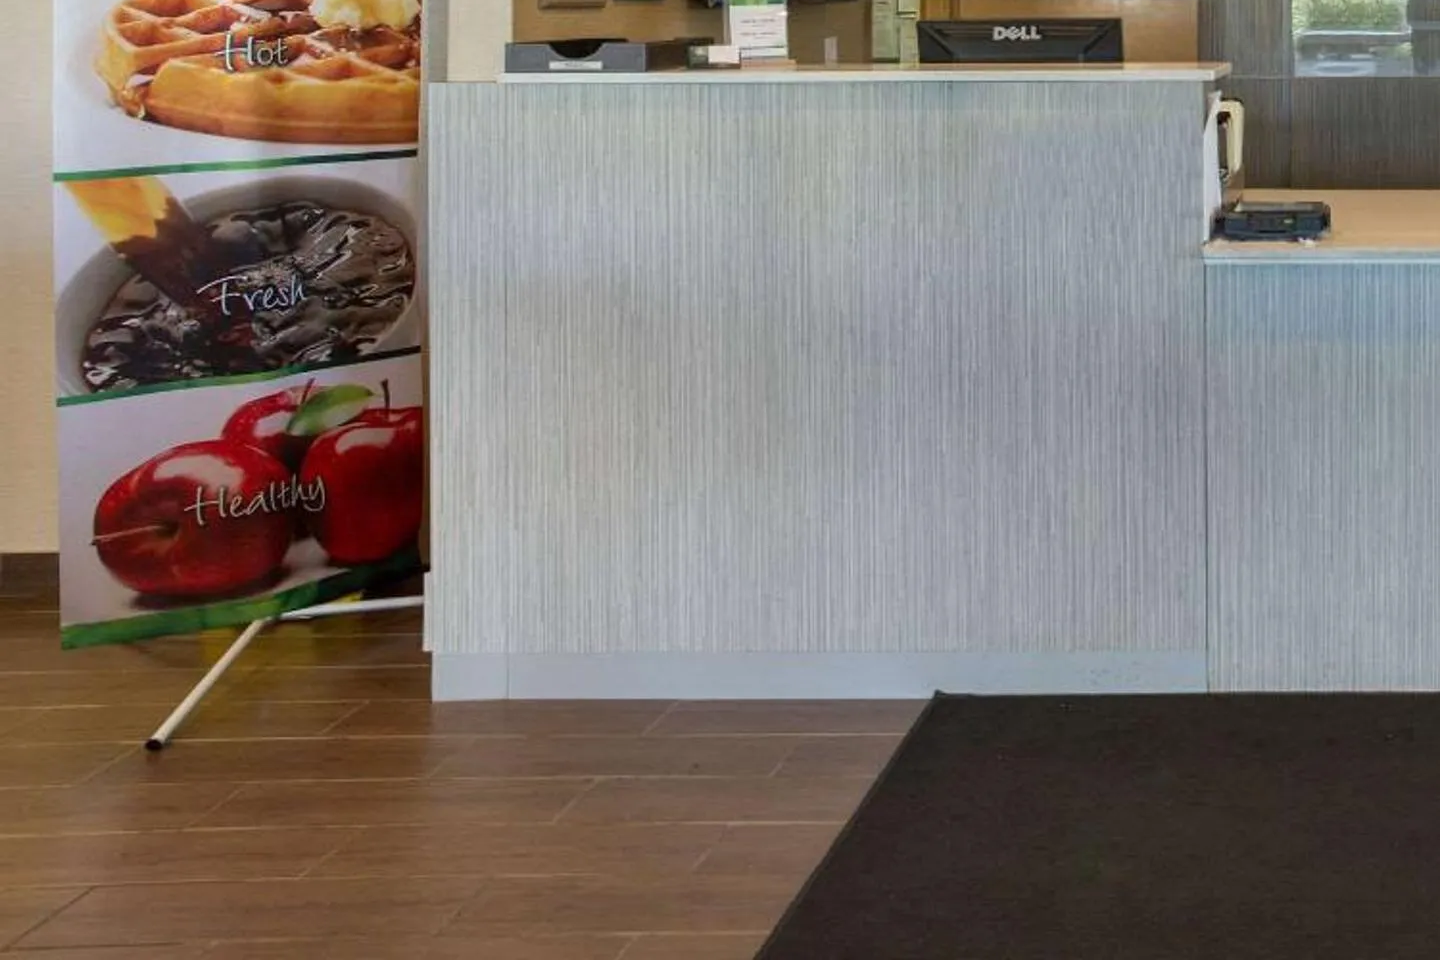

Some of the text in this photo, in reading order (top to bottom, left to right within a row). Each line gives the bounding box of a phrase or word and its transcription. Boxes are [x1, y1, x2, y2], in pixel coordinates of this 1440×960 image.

[213, 32, 290, 74] Hot
[992, 26, 1042, 41] DELL
[196, 275, 308, 316] Fresh
[184, 474, 325, 526] Healthy
